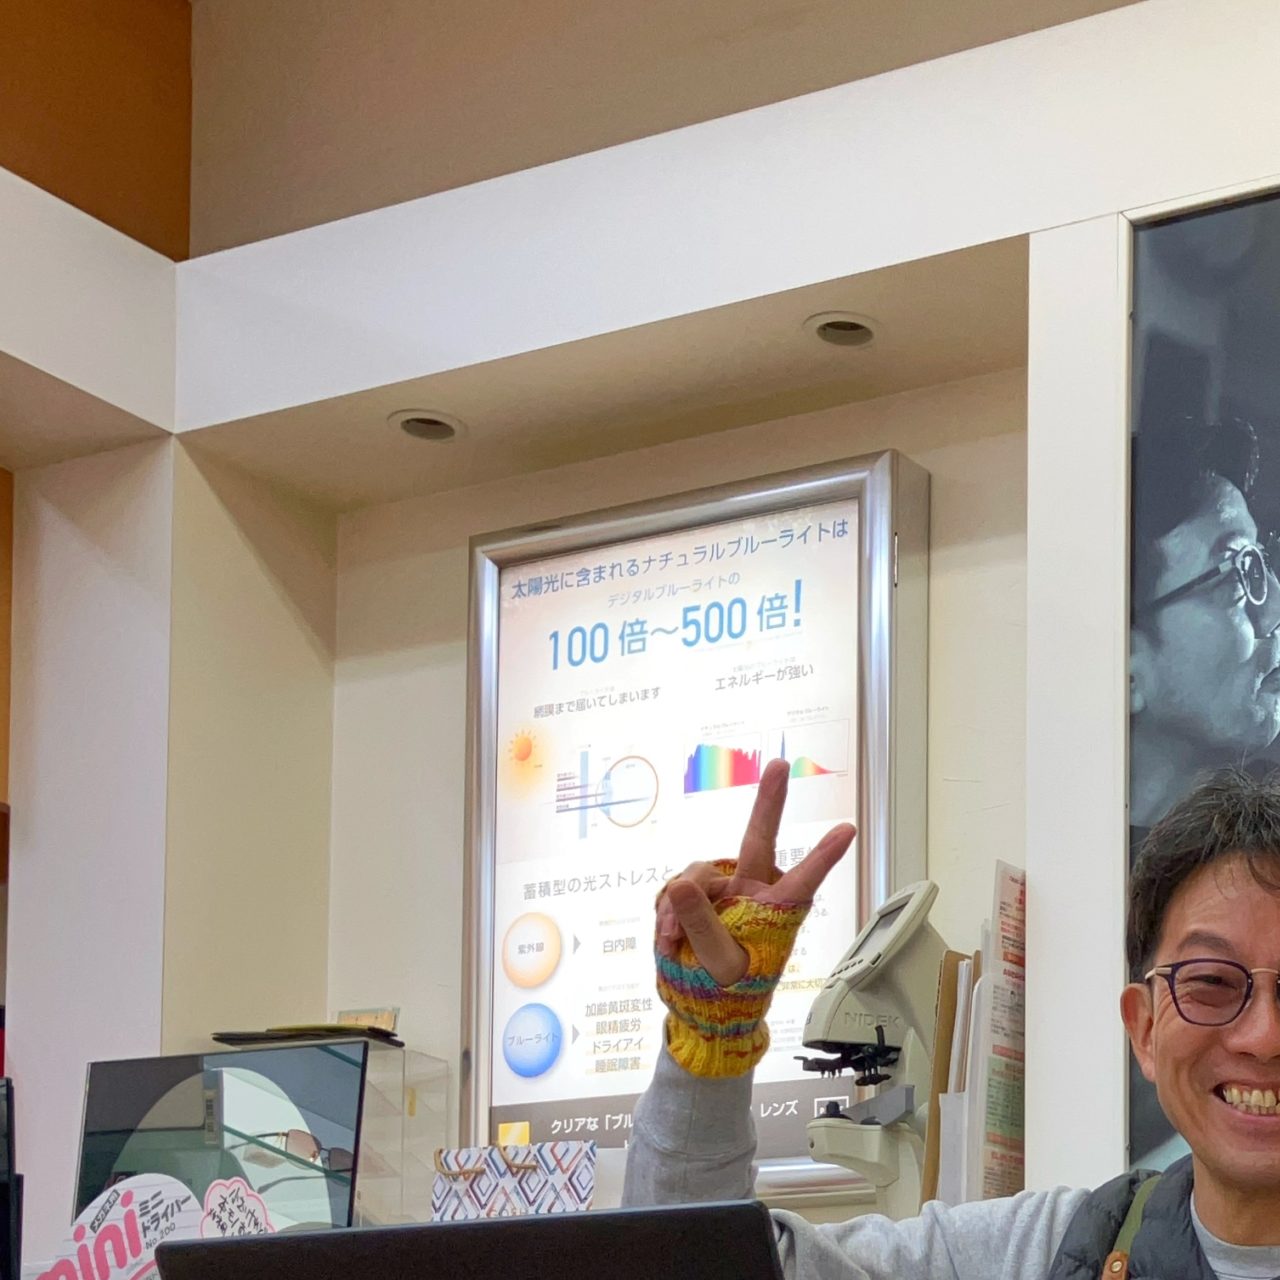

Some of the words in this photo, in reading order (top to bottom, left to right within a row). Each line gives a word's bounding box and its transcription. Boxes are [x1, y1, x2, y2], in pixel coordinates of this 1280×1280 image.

[512, 519, 849, 599] 太陽光に含まれるナチュラルブルーライトは
[608, 572, 740, 608] デジタルブルーライトの
[715, 664, 813, 691] エネルギーが強い
[603, 937, 637, 953] 白内障
[585, 998, 652, 1017] 加齢黄斑変性
[596, 1019, 641, 1035] 眼精疲労
[844, 1011, 900, 1028] NIDEK
[507, 1031, 558, 1046] ブルーライト
[593, 1037, 643, 1055] ドライアイ
[595, 1057, 641, 1073] 睡眠障害
[138, 1190, 164, 1218] ミニ
[141, 1195, 192, 1239] ドライバー
